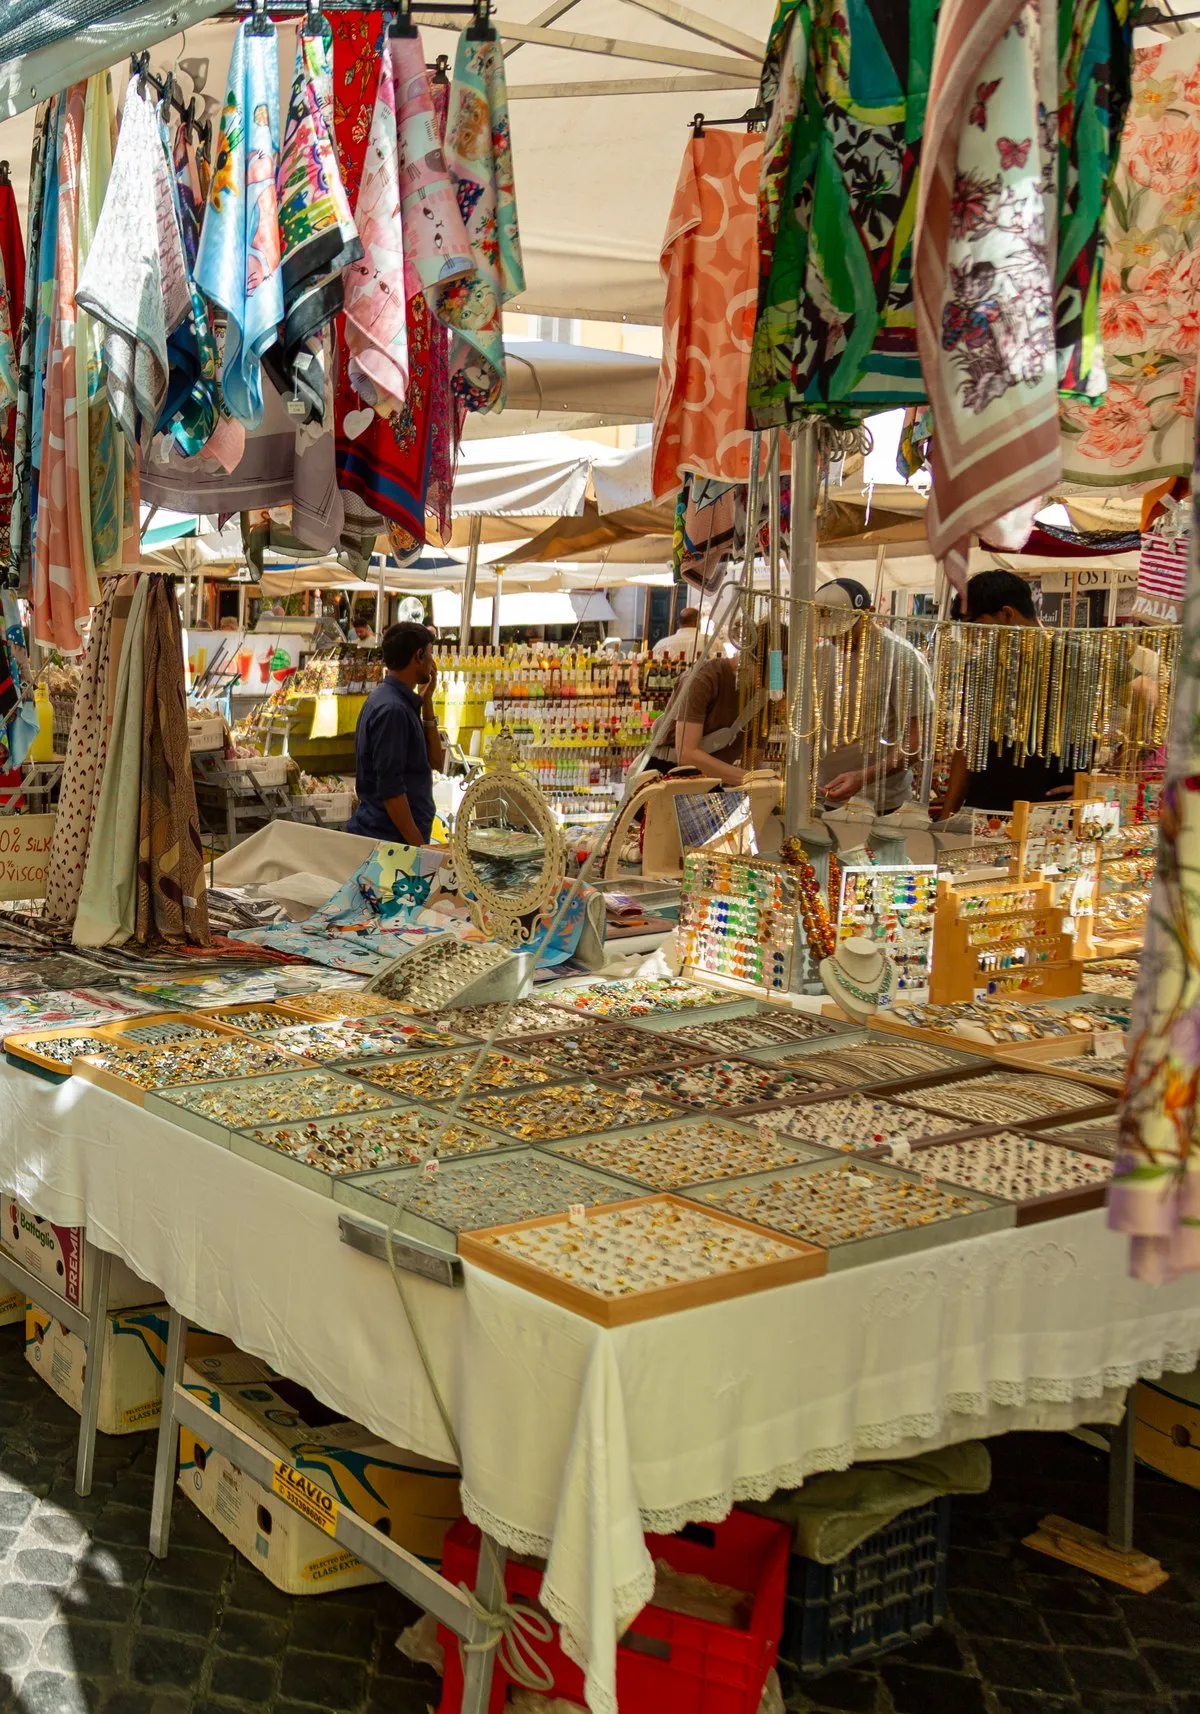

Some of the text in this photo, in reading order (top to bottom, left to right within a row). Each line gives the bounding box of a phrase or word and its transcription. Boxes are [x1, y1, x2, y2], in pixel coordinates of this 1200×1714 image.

[1131, 596, 1178, 623] ITALIA
[20, 1212, 55, 1250] Battaglio
[279, 1463, 333, 1511] FLAVIO
[312, 1566, 338, 1580] CLASS
